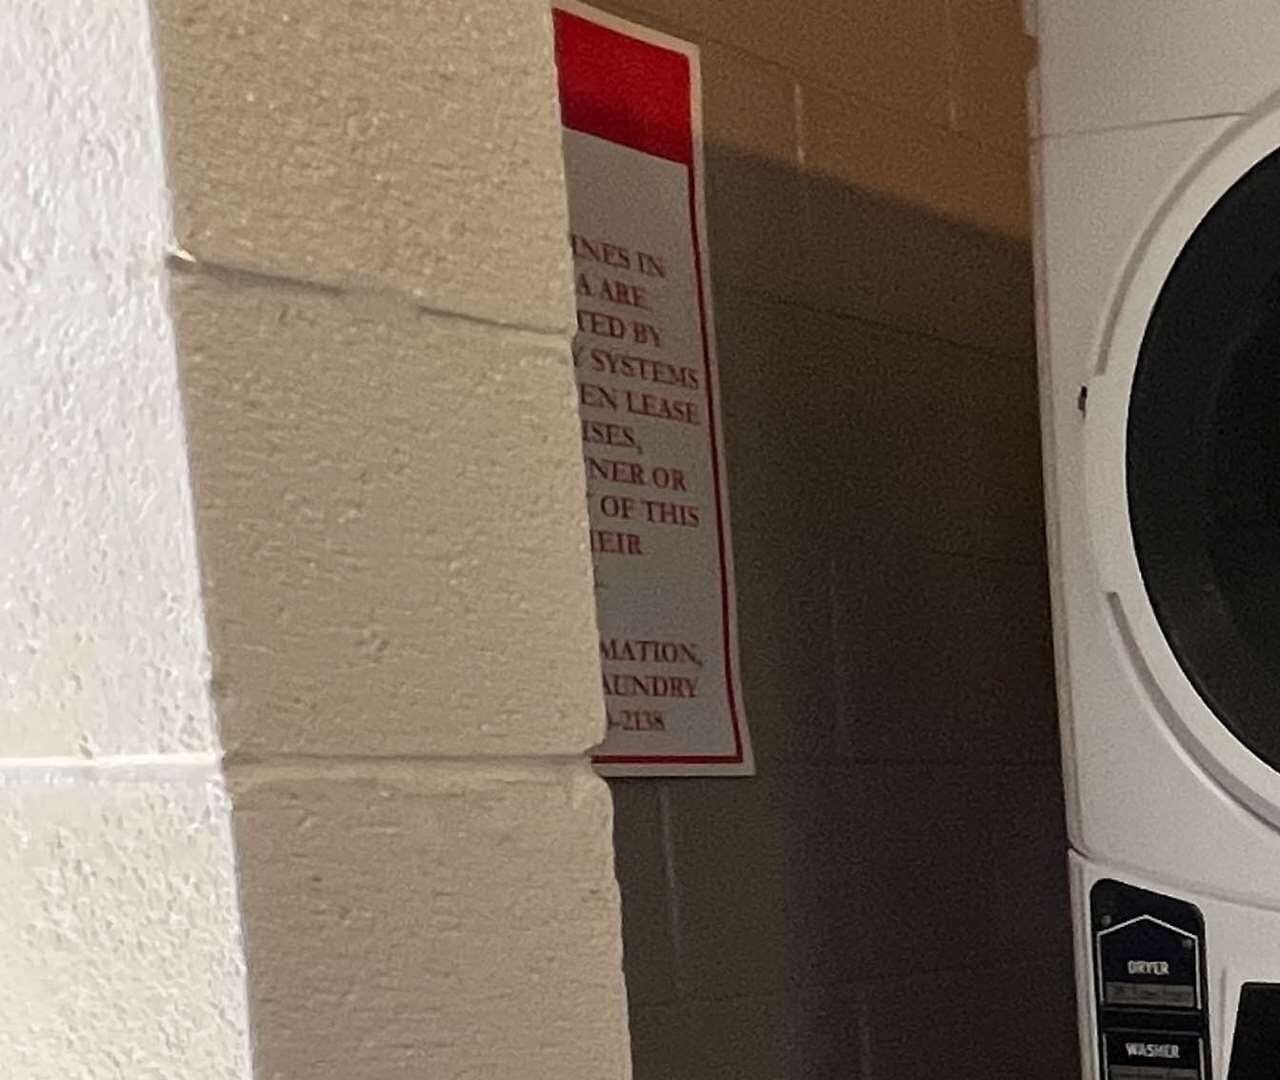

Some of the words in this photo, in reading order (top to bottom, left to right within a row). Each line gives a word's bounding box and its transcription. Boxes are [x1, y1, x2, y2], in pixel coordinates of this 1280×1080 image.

[638, 252, 667, 279] IN
[601, 278, 651, 310] ARE
[630, 320, 662, 348] BY
[591, 350, 699, 390] SYSTEMS
[625, 391, 702, 426] LEASE
[652, 467, 687, 492] OR
[601, 495, 634, 519] OF
[640, 500, 700, 529] THIS
[1127, 959, 1170, 976] DRYER
[1125, 1042, 1181, 1059] WASHER
